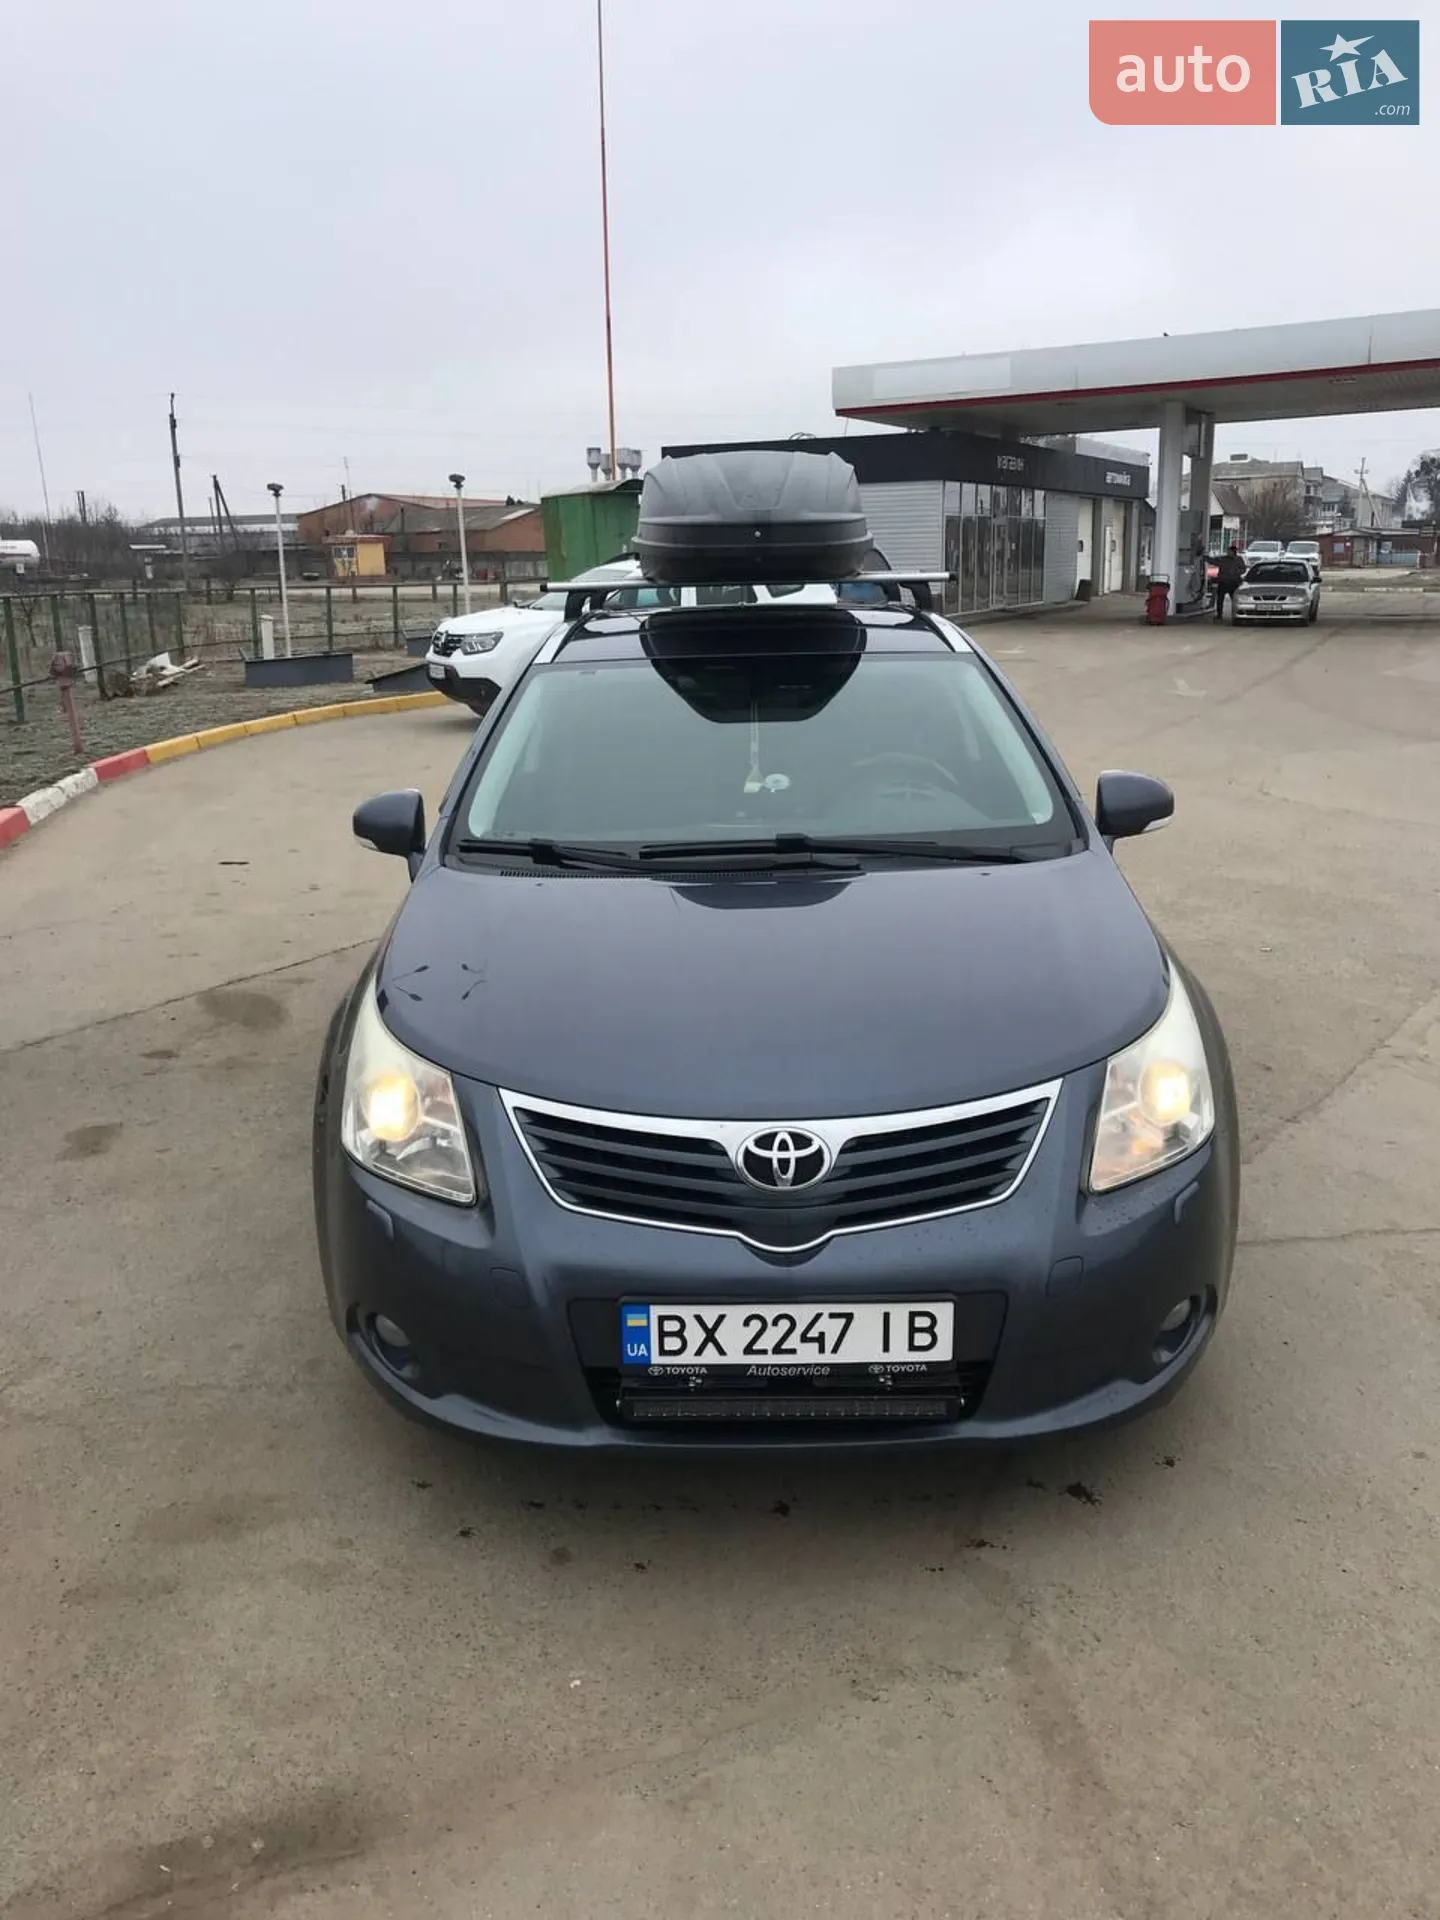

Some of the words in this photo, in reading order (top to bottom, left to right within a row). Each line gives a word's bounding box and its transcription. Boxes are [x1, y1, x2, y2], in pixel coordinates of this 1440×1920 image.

[657, 1313, 728, 1357] BX
[742, 1311, 855, 1356] 2247
[882, 1309, 939, 1354] IB
[626, 1343, 648, 1357] UA
[665, 1365, 708, 1375] TOYOTA
[746, 1364, 831, 1377] Autoservice
[886, 1363, 928, 1373] TOYOTA
